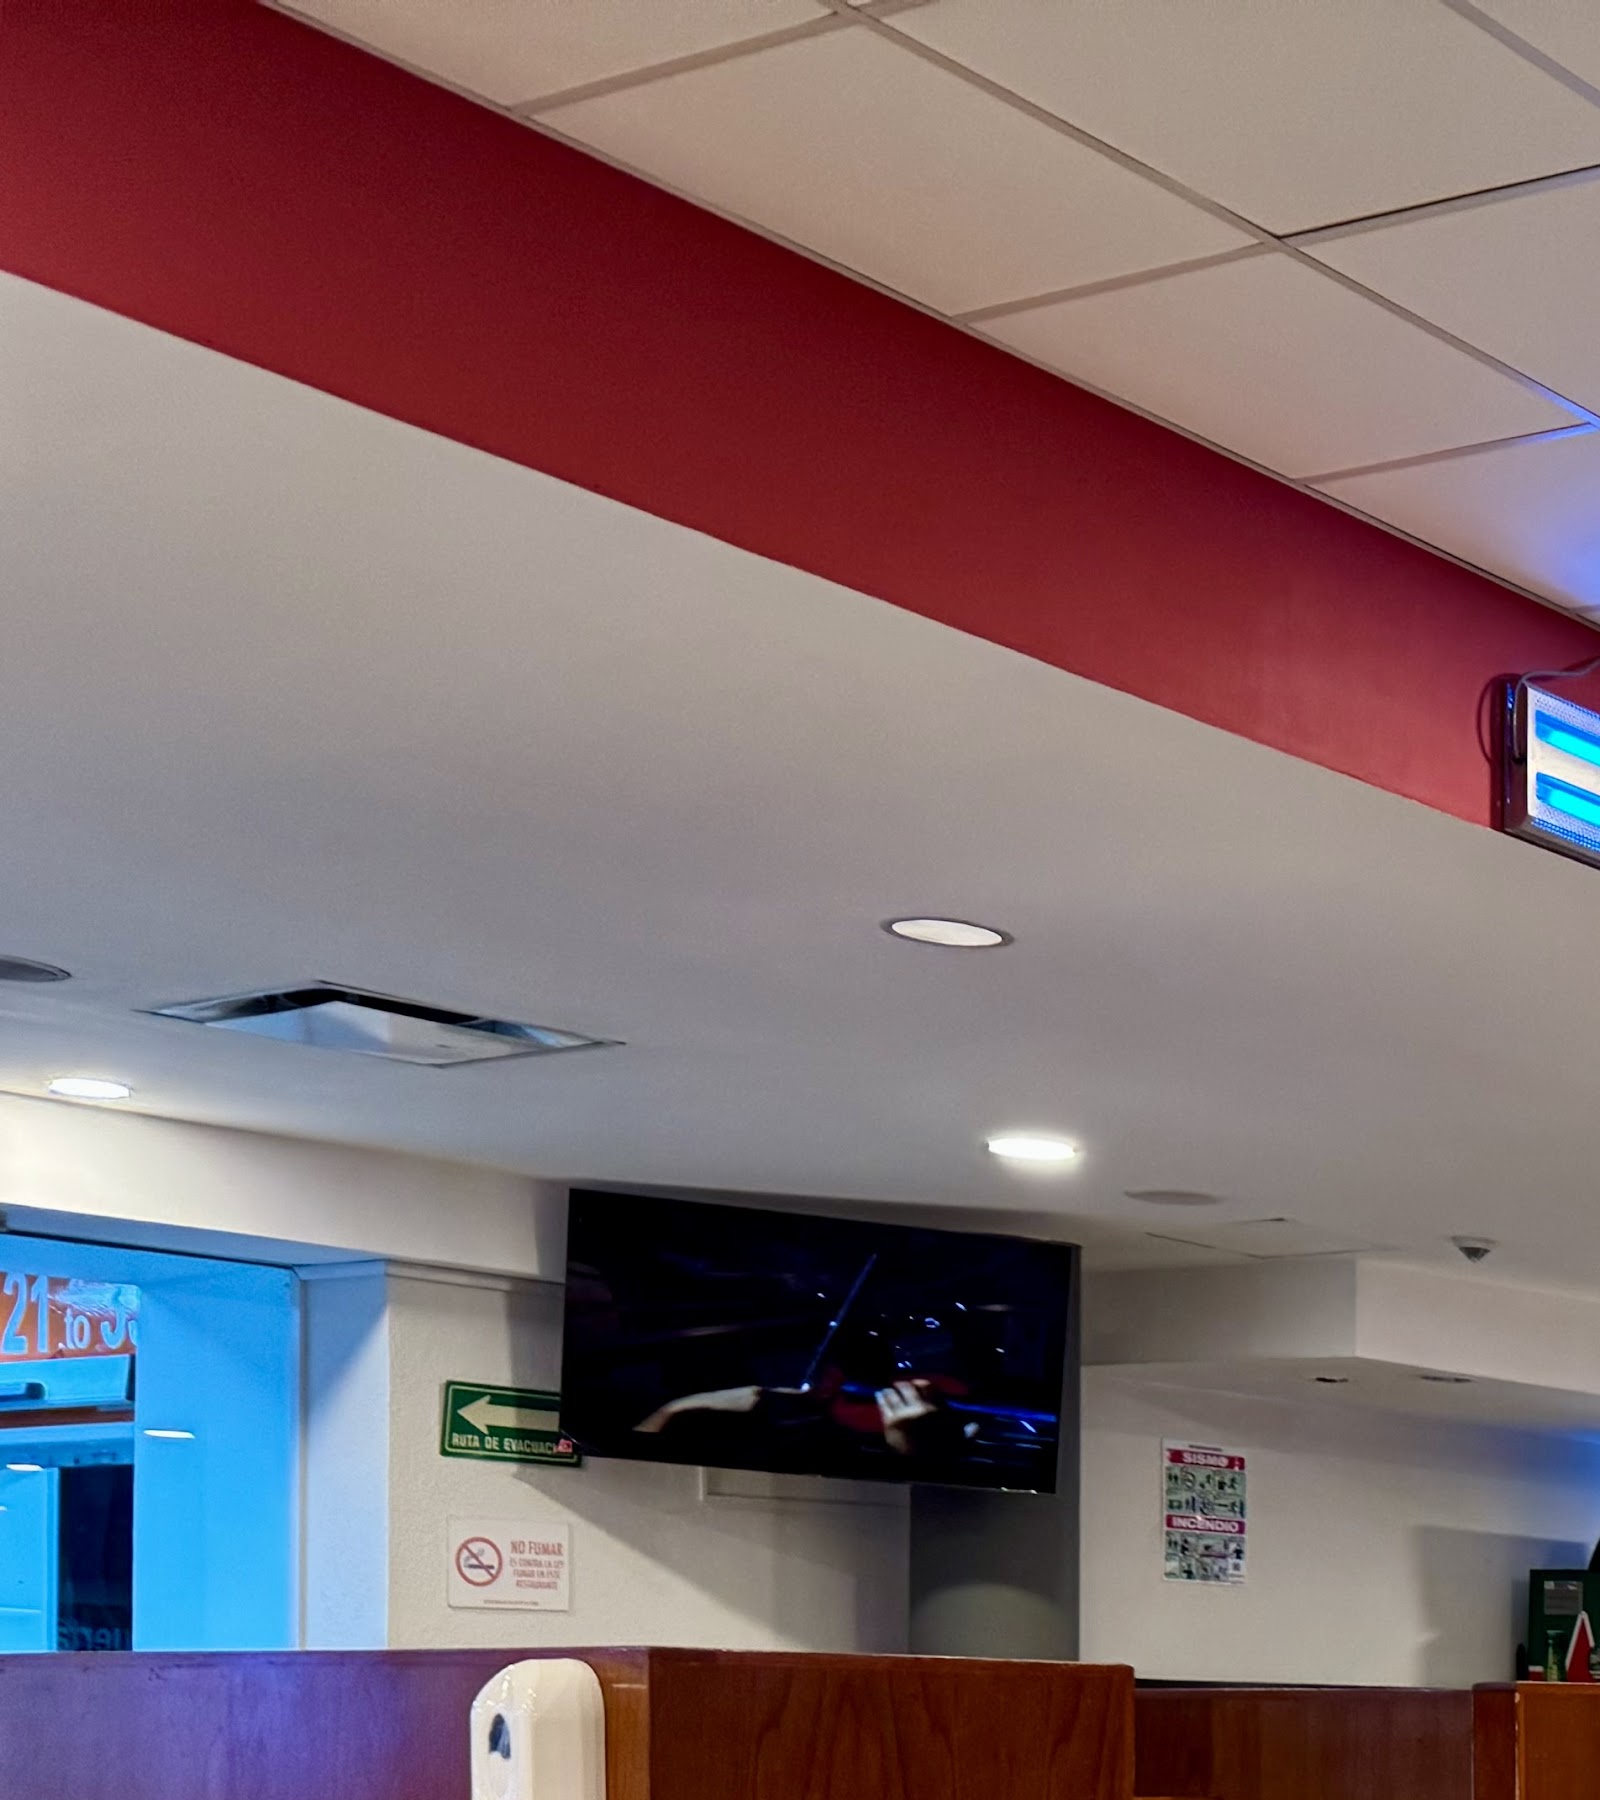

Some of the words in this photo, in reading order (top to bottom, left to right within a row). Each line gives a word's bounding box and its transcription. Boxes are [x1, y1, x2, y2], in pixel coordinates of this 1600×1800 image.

[452, 1433, 480, 1447] RUTA
[484, 1436, 499, 1450] DE
[1172, 1516, 1239, 1532] INCENDIO
[510, 1541, 525, 1554] NO
